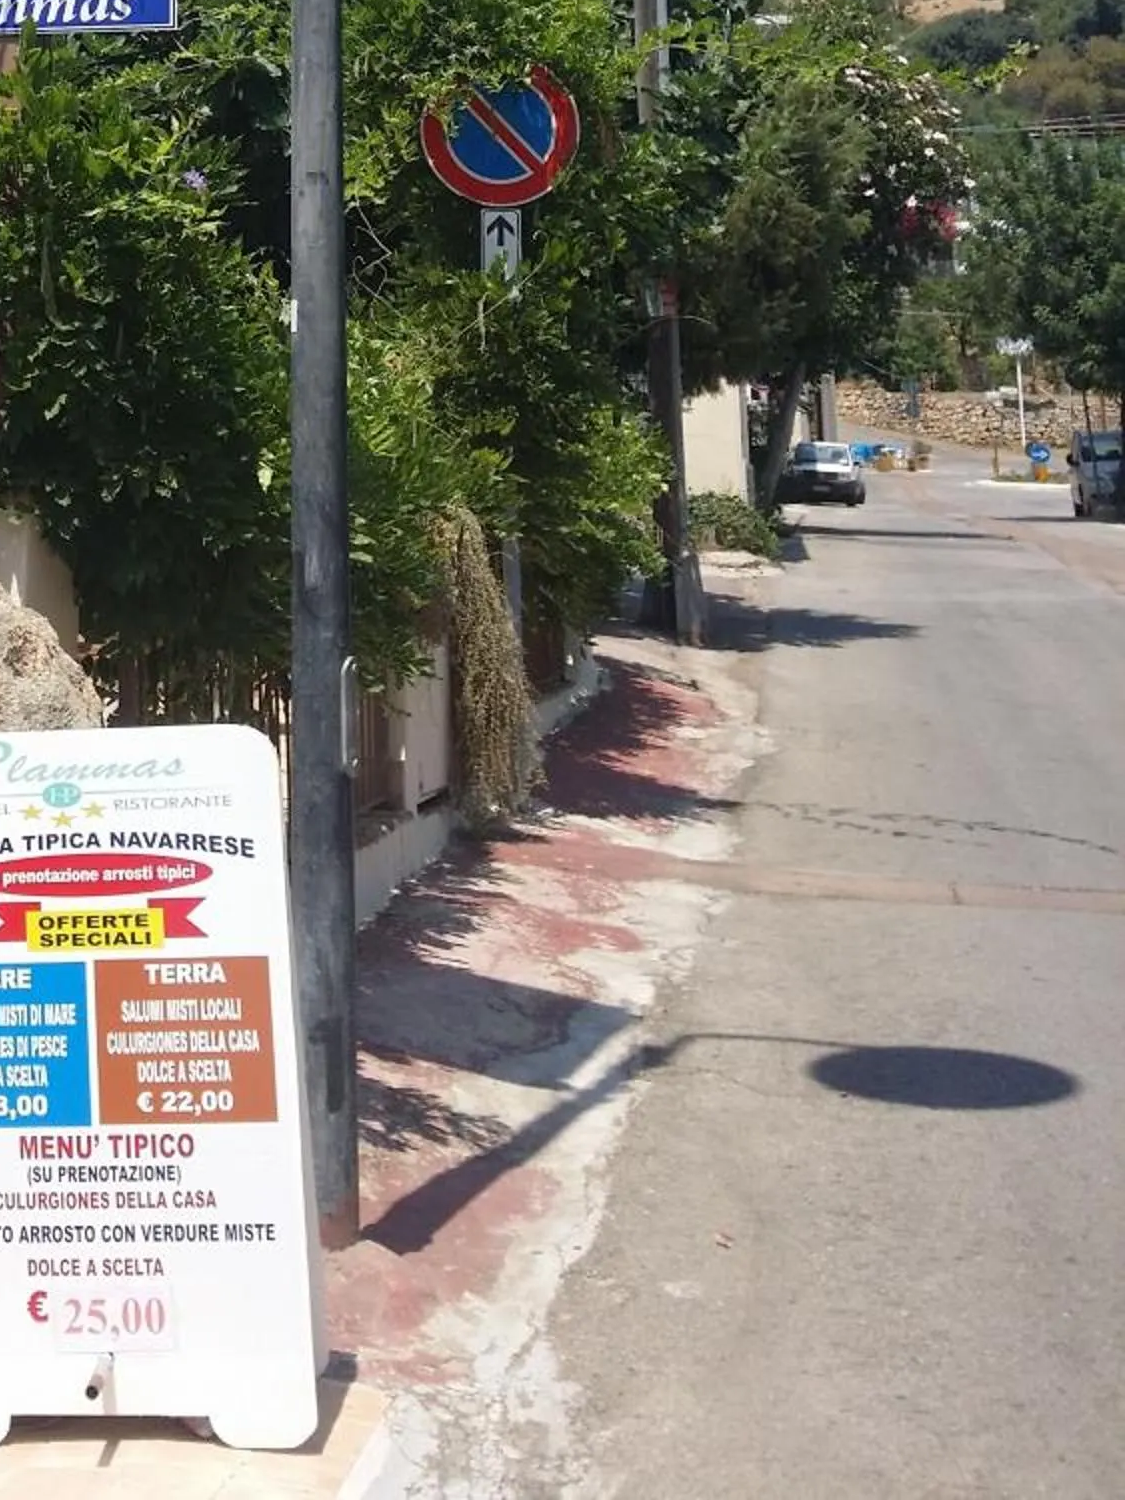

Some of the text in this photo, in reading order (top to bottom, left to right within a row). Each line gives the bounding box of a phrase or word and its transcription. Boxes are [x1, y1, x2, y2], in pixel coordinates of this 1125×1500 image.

[113, 795, 232, 811] RISTORANTE
[22, 832, 101, 852] TIPICA
[110, 832, 255, 858] NAVARRESE
[2, 868, 99, 888] prenotazione
[103, 865, 153, 881] arrosti
[156, 864, 195, 882] tipici
[39, 914, 149, 930] OFFERTE
[40, 932, 151, 947] SPECIALI
[144, 963, 226, 985] TERRA
[31, 1004, 42, 1025] DI
[45, 1004, 76, 1025] MARE
[121, 998, 241, 1022] SALUMI MISTI LOCALI
[17, 1036, 28, 1058] DI
[32, 1036, 68, 1058] PESCE
[107, 1030, 260, 1054] CULURGIONES DELLA CASA
[7, 1065, 48, 1087] SCELTA
[137, 1060, 232, 1083] DOLCE A SCELTA
[137, 1090, 233, 1116] € 22,00
[107, 1134, 195, 1158] TIPICO
[28, 1165, 182, 1185] (SU PRENOTAZIONE)
[116, 1192, 167, 1209] DELLA
[172, 1190, 217, 1208] CASA
[19, 1226, 95, 1243] ARROSTO
[101, 1225, 136, 1242] CON
[141, 1224, 219, 1242] VERDURE
[225, 1224, 275, 1241] MISTE
[28, 1258, 164, 1276] DOLCE A SCELTA
[27, 1290, 165, 1341] € 25,00
